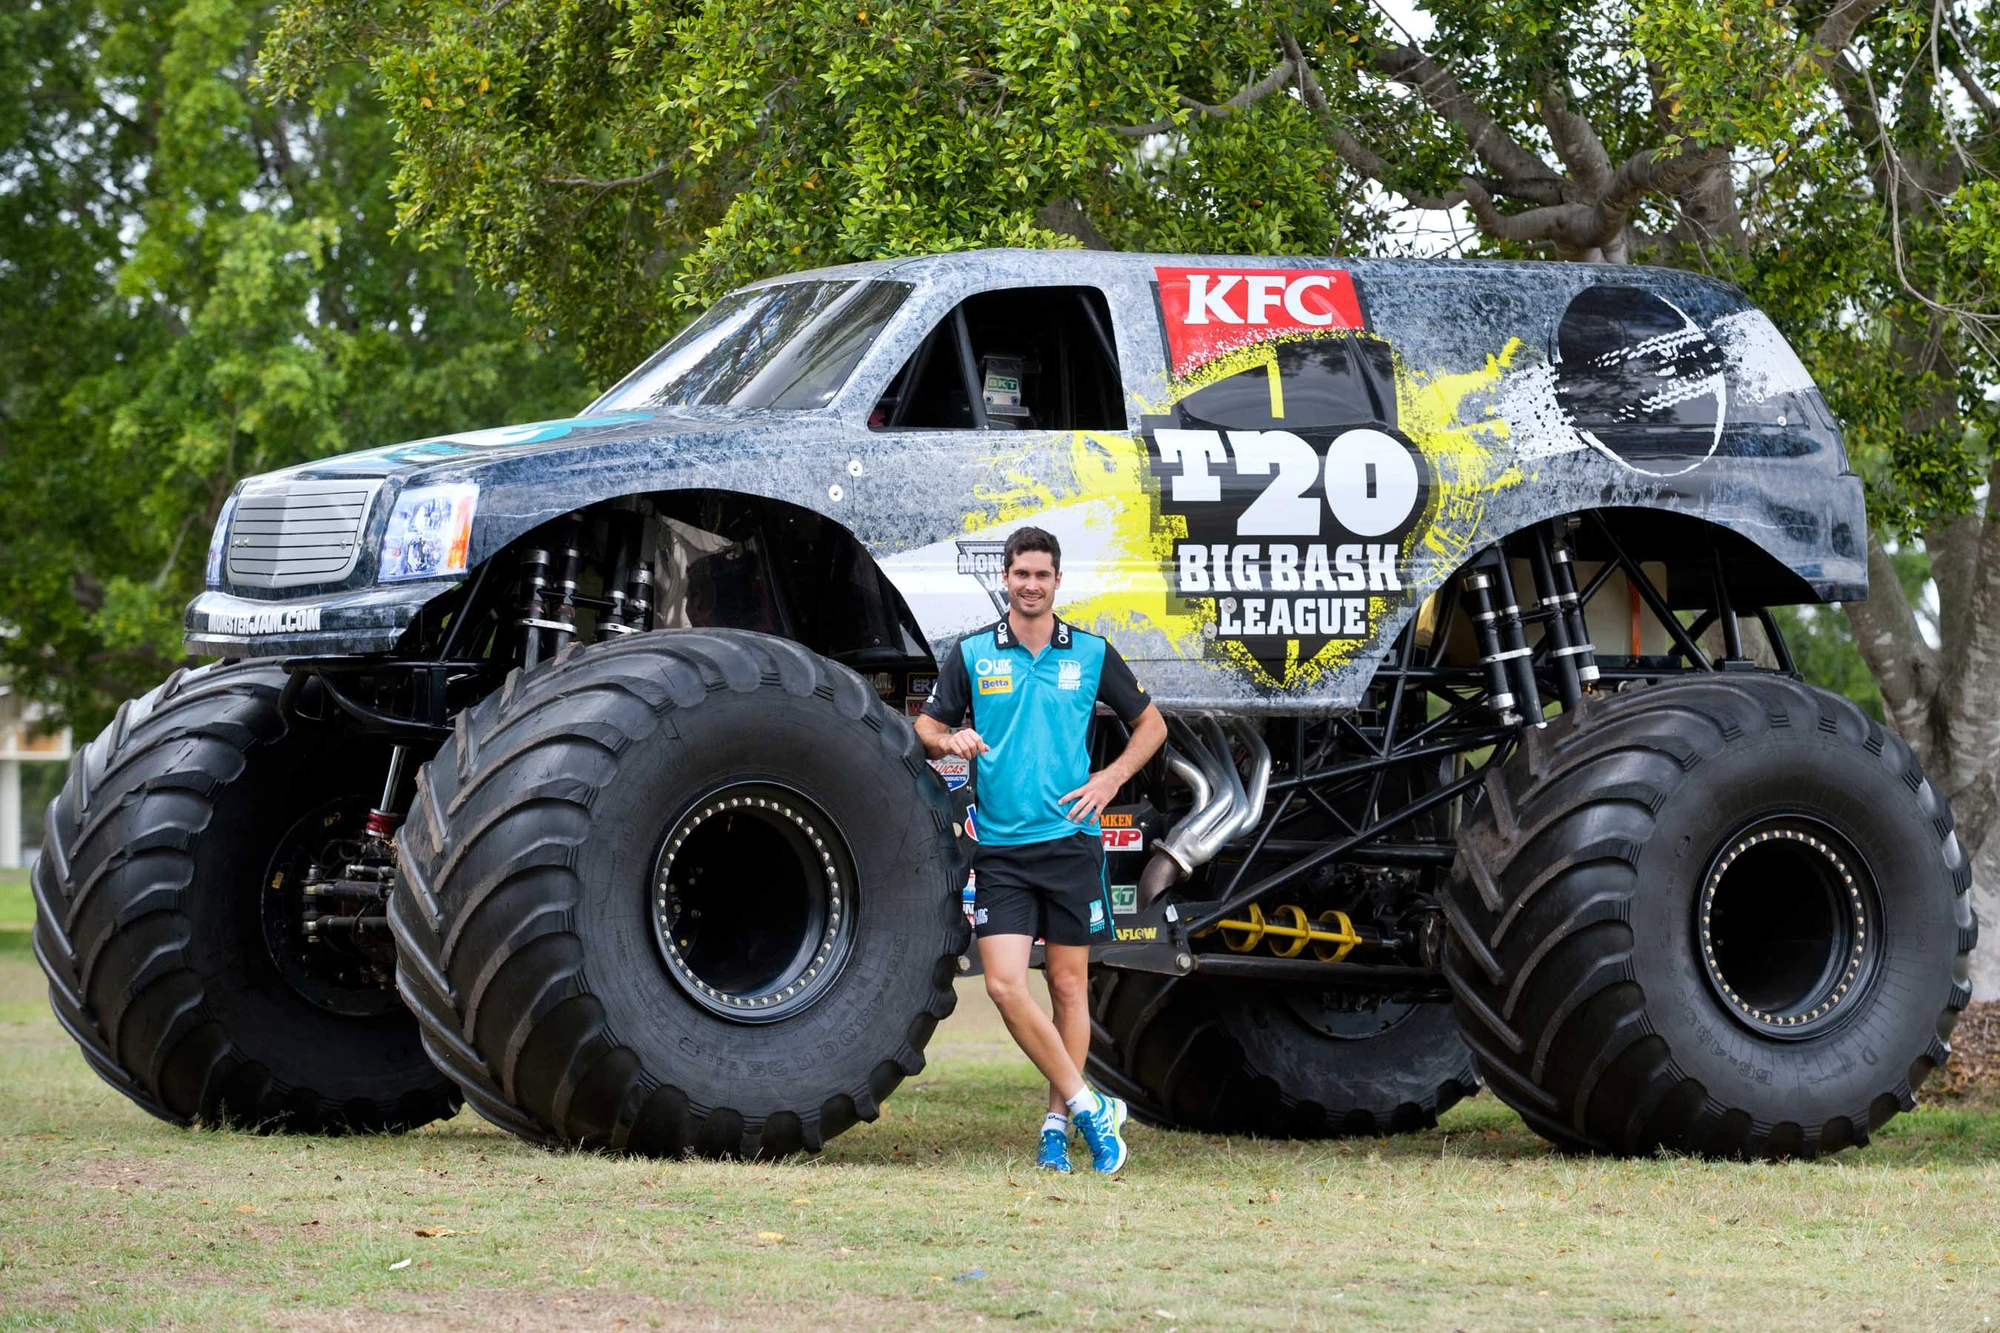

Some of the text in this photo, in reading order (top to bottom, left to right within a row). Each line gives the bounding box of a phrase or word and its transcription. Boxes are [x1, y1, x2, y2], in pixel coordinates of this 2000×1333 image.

[1184, 274, 1333, 325] KFC
[987, 376, 1018, 390] BKT
[1153, 428, 1418, 536] T20
[958, 553, 1005, 573] MON
[1177, 544, 1403, 592] BIG BASH
[1218, 598, 1366, 635] LEAGUE
[981, 679, 1009, 690] Betta
